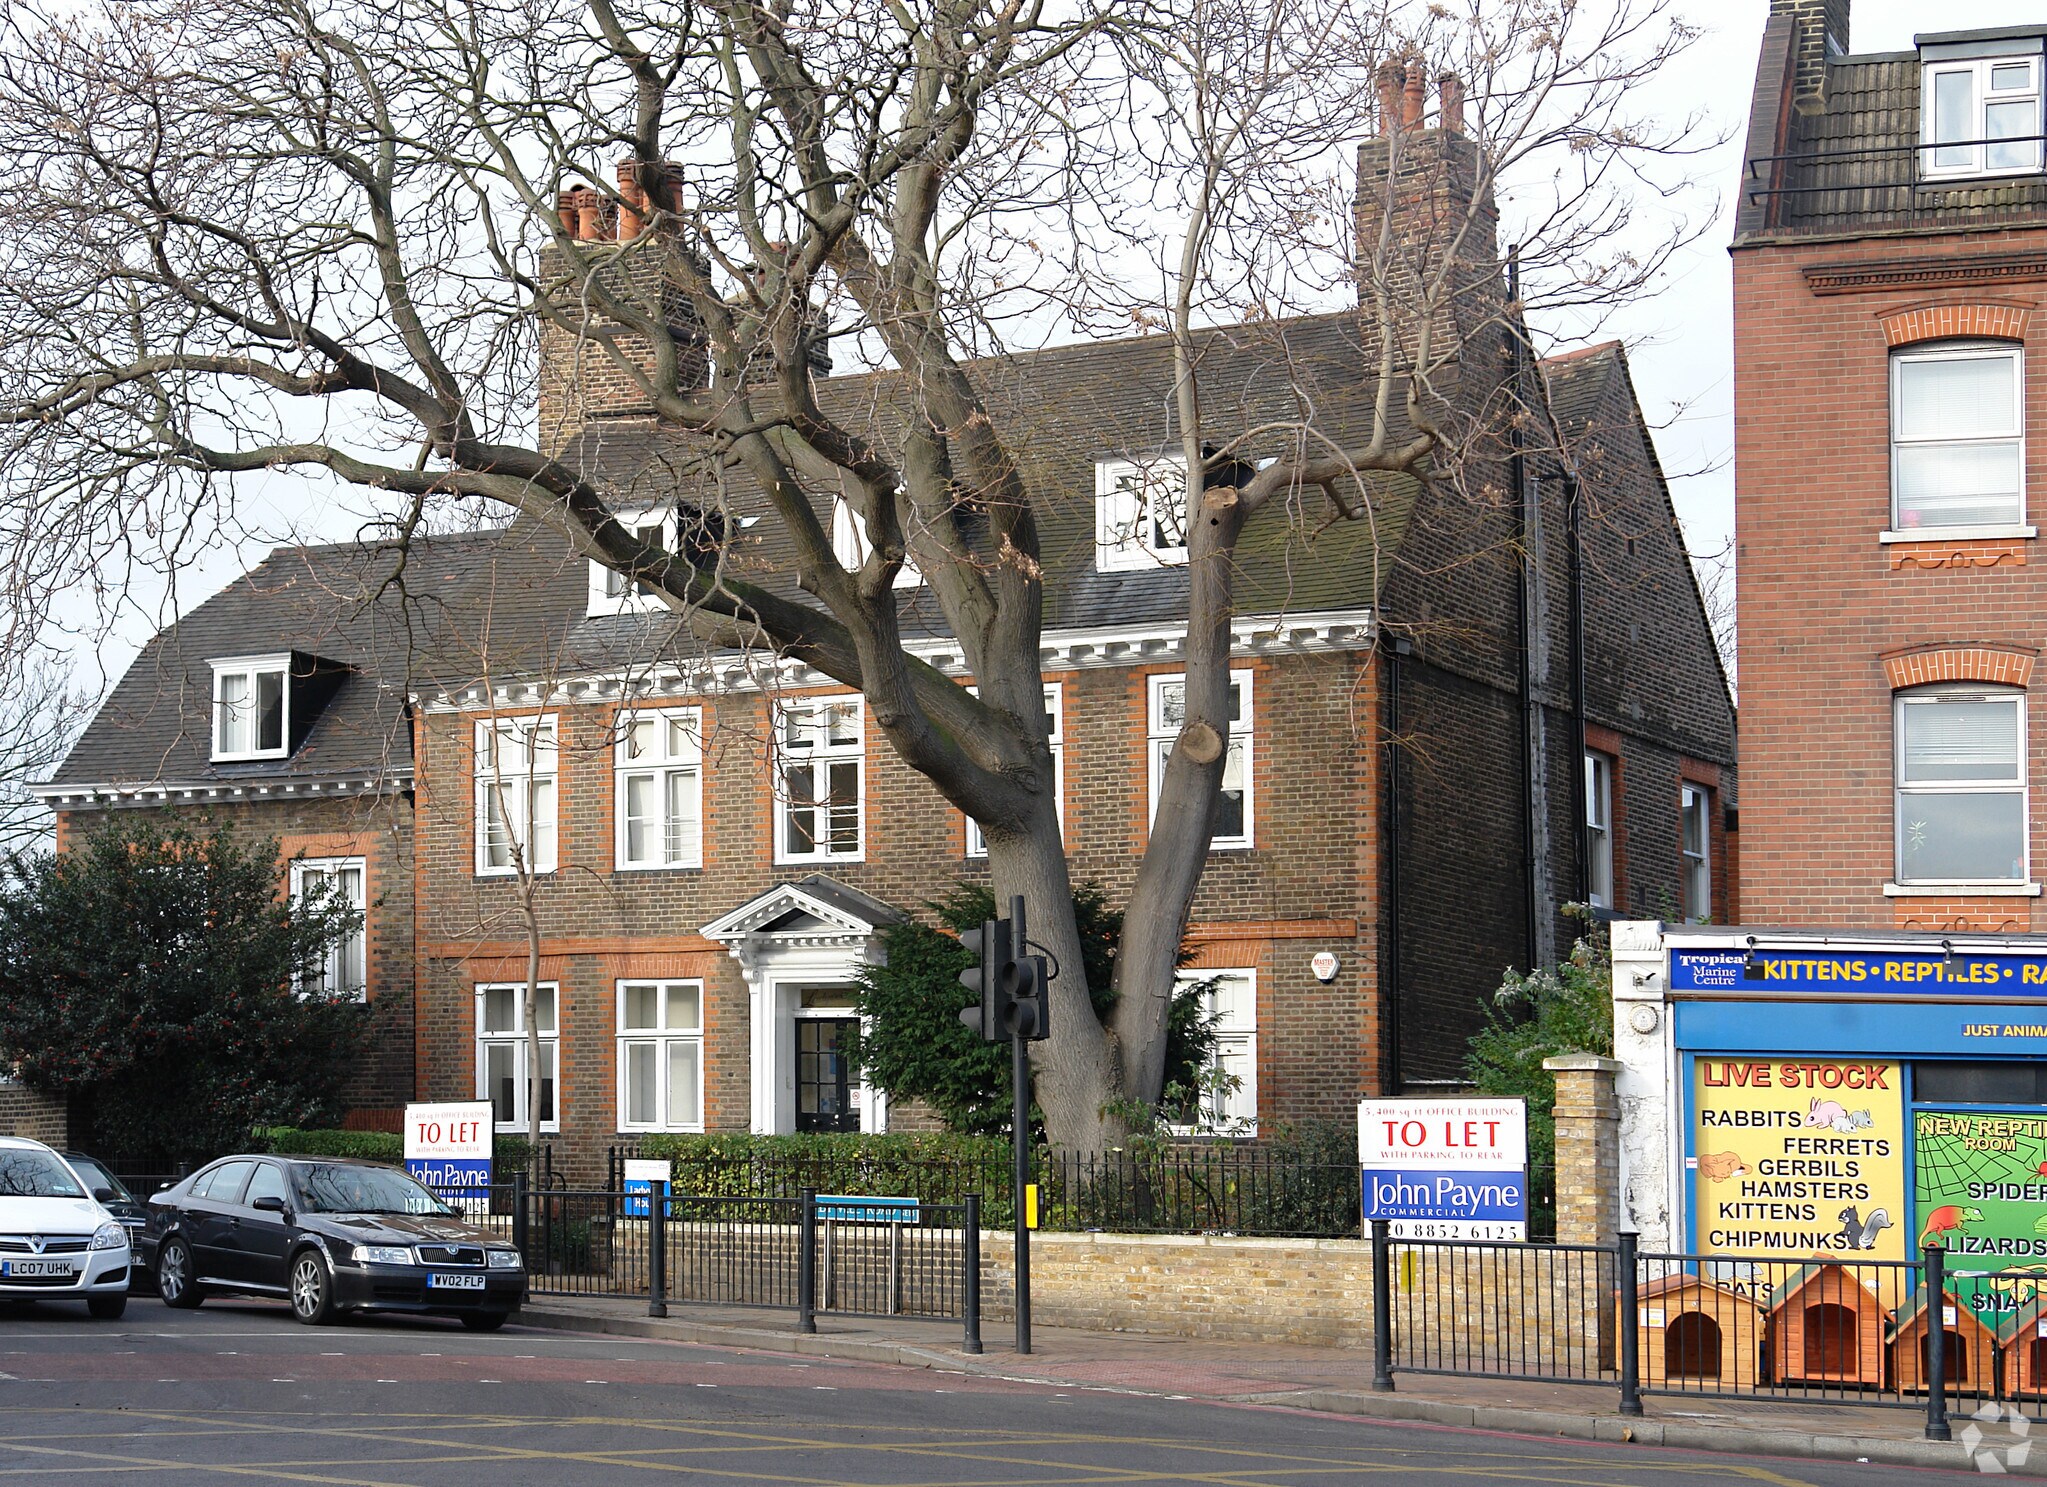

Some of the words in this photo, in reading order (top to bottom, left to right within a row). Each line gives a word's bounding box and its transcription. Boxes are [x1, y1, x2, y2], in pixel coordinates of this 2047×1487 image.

[1693, 965, 1737, 977] Marine
[1764, 960, 1867, 981] KITTENS
[1693, 974, 1736, 986] Centre
[1963, 1024, 1999, 1037] JUST
[1704, 1063, 1771, 1087] LIVE
[1779, 1064, 1889, 1090] STOCK
[1426, 1107, 1462, 1116] OFFICE
[1467, 1107, 1518, 1116] BUILDING
[1701, 1110, 1801, 1128] RABBITS
[418, 1122, 441, 1144] TO
[450, 1122, 479, 1143] LET
[1382, 1120, 1427, 1147] TO
[1445, 1121, 1500, 1147] LET
[1920, 1118, 1972, 1136] NEW
[1784, 1138, 1890, 1156] FERRETS
[1965, 1137, 2017, 1151] ROOM
[1380, 1150, 1407, 1159] WITH
[1411, 1151, 1455, 1160] PARKING
[1460, 1151, 1473, 1160] TO
[1477, 1151, 1503, 1160] REAR
[1758, 1159, 1860, 1178] GERBILS
[411, 1162, 442, 1186] John
[445, 1164, 488, 1195] Payne
[1370, 1174, 1430, 1215] John
[1436, 1176, 1520, 1216] Payne
[1742, 1181, 1869, 1200] HAMSTERS
[1380, 1208, 1466, 1217] COMMERCIAL
[1719, 1203, 1816, 1221] KITTENS
[1414, 1224, 1459, 1238] 8852
[1471, 1225, 1517, 1240] 6125
[1709, 1230, 1847, 1250] CHIPMUNKS
[1946, 1236, 2047, 1256] LIZARDS
[11, 1263, 44, 1274] LC07
[47, 1263, 71, 1274] UHK
[434, 1275, 462, 1287] WV02
[464, 1276, 484, 1287] FLP
[1971, 1292, 2036, 1311] SNA
